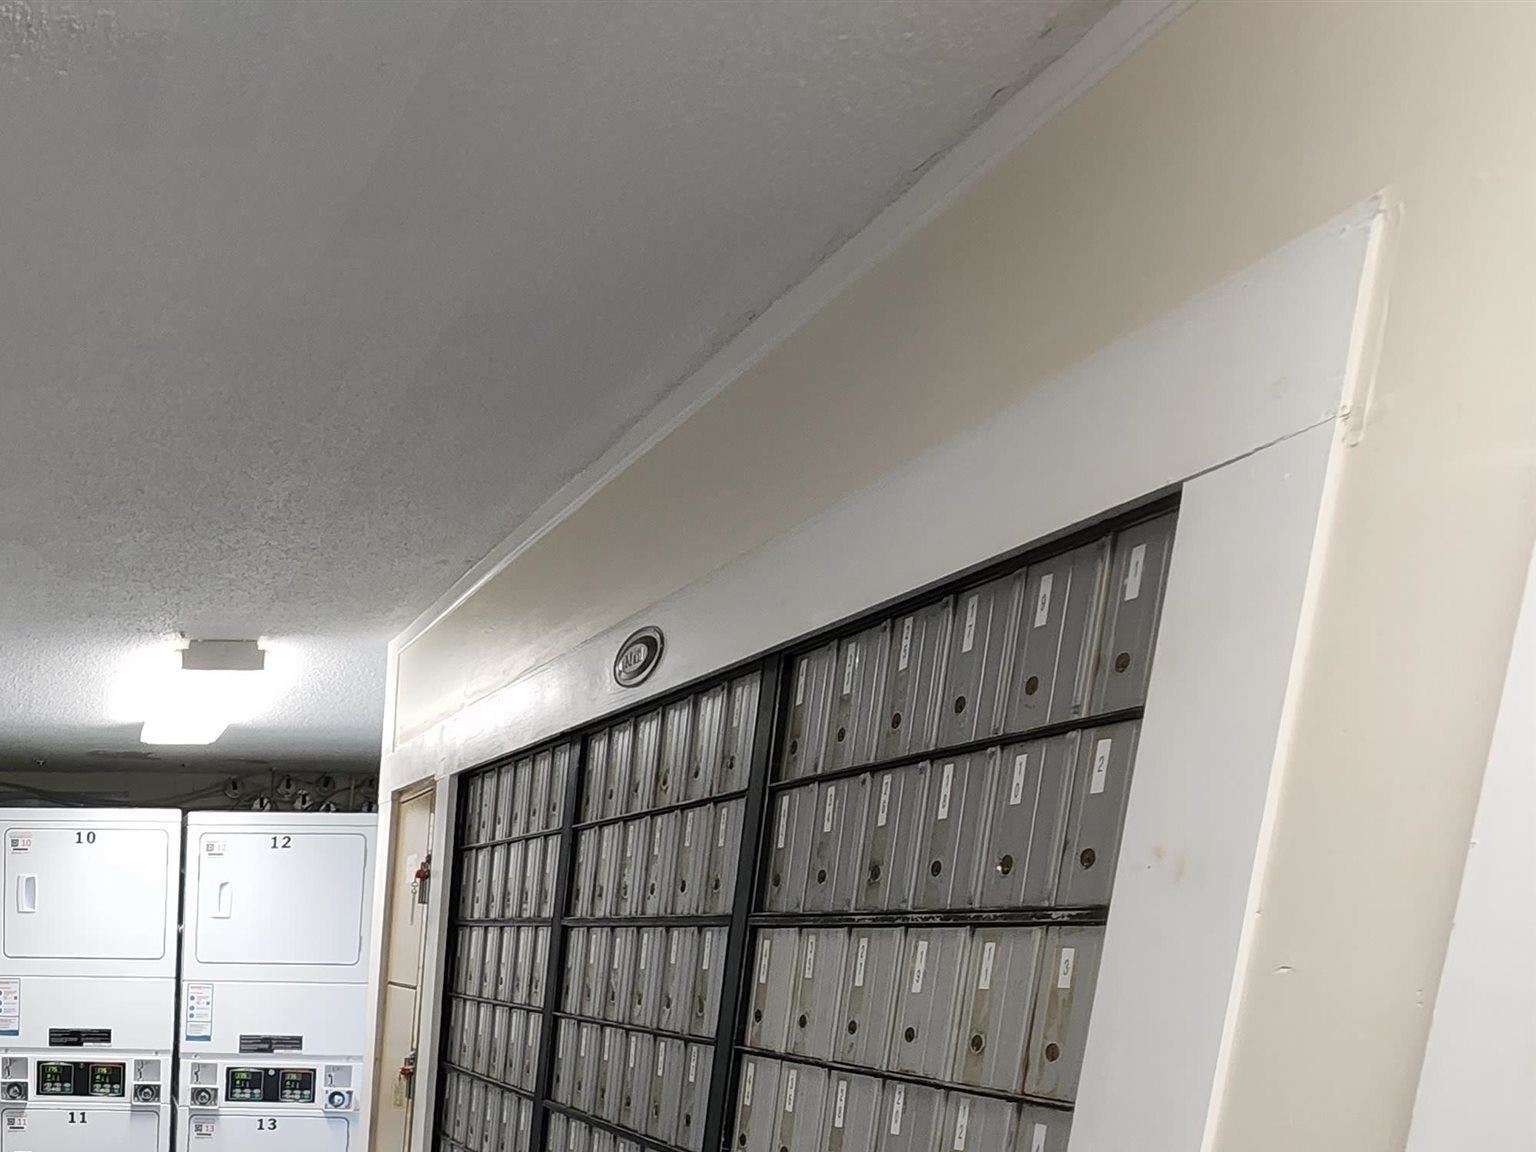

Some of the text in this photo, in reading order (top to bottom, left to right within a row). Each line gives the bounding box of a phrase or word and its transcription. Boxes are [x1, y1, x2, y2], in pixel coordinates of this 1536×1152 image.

[21, 838, 32, 847] 10
[75, 830, 97, 845] 10
[270, 836, 292, 850] 12
[68, 1111, 88, 1124] 11
[256, 1118, 277, 1131] 13
